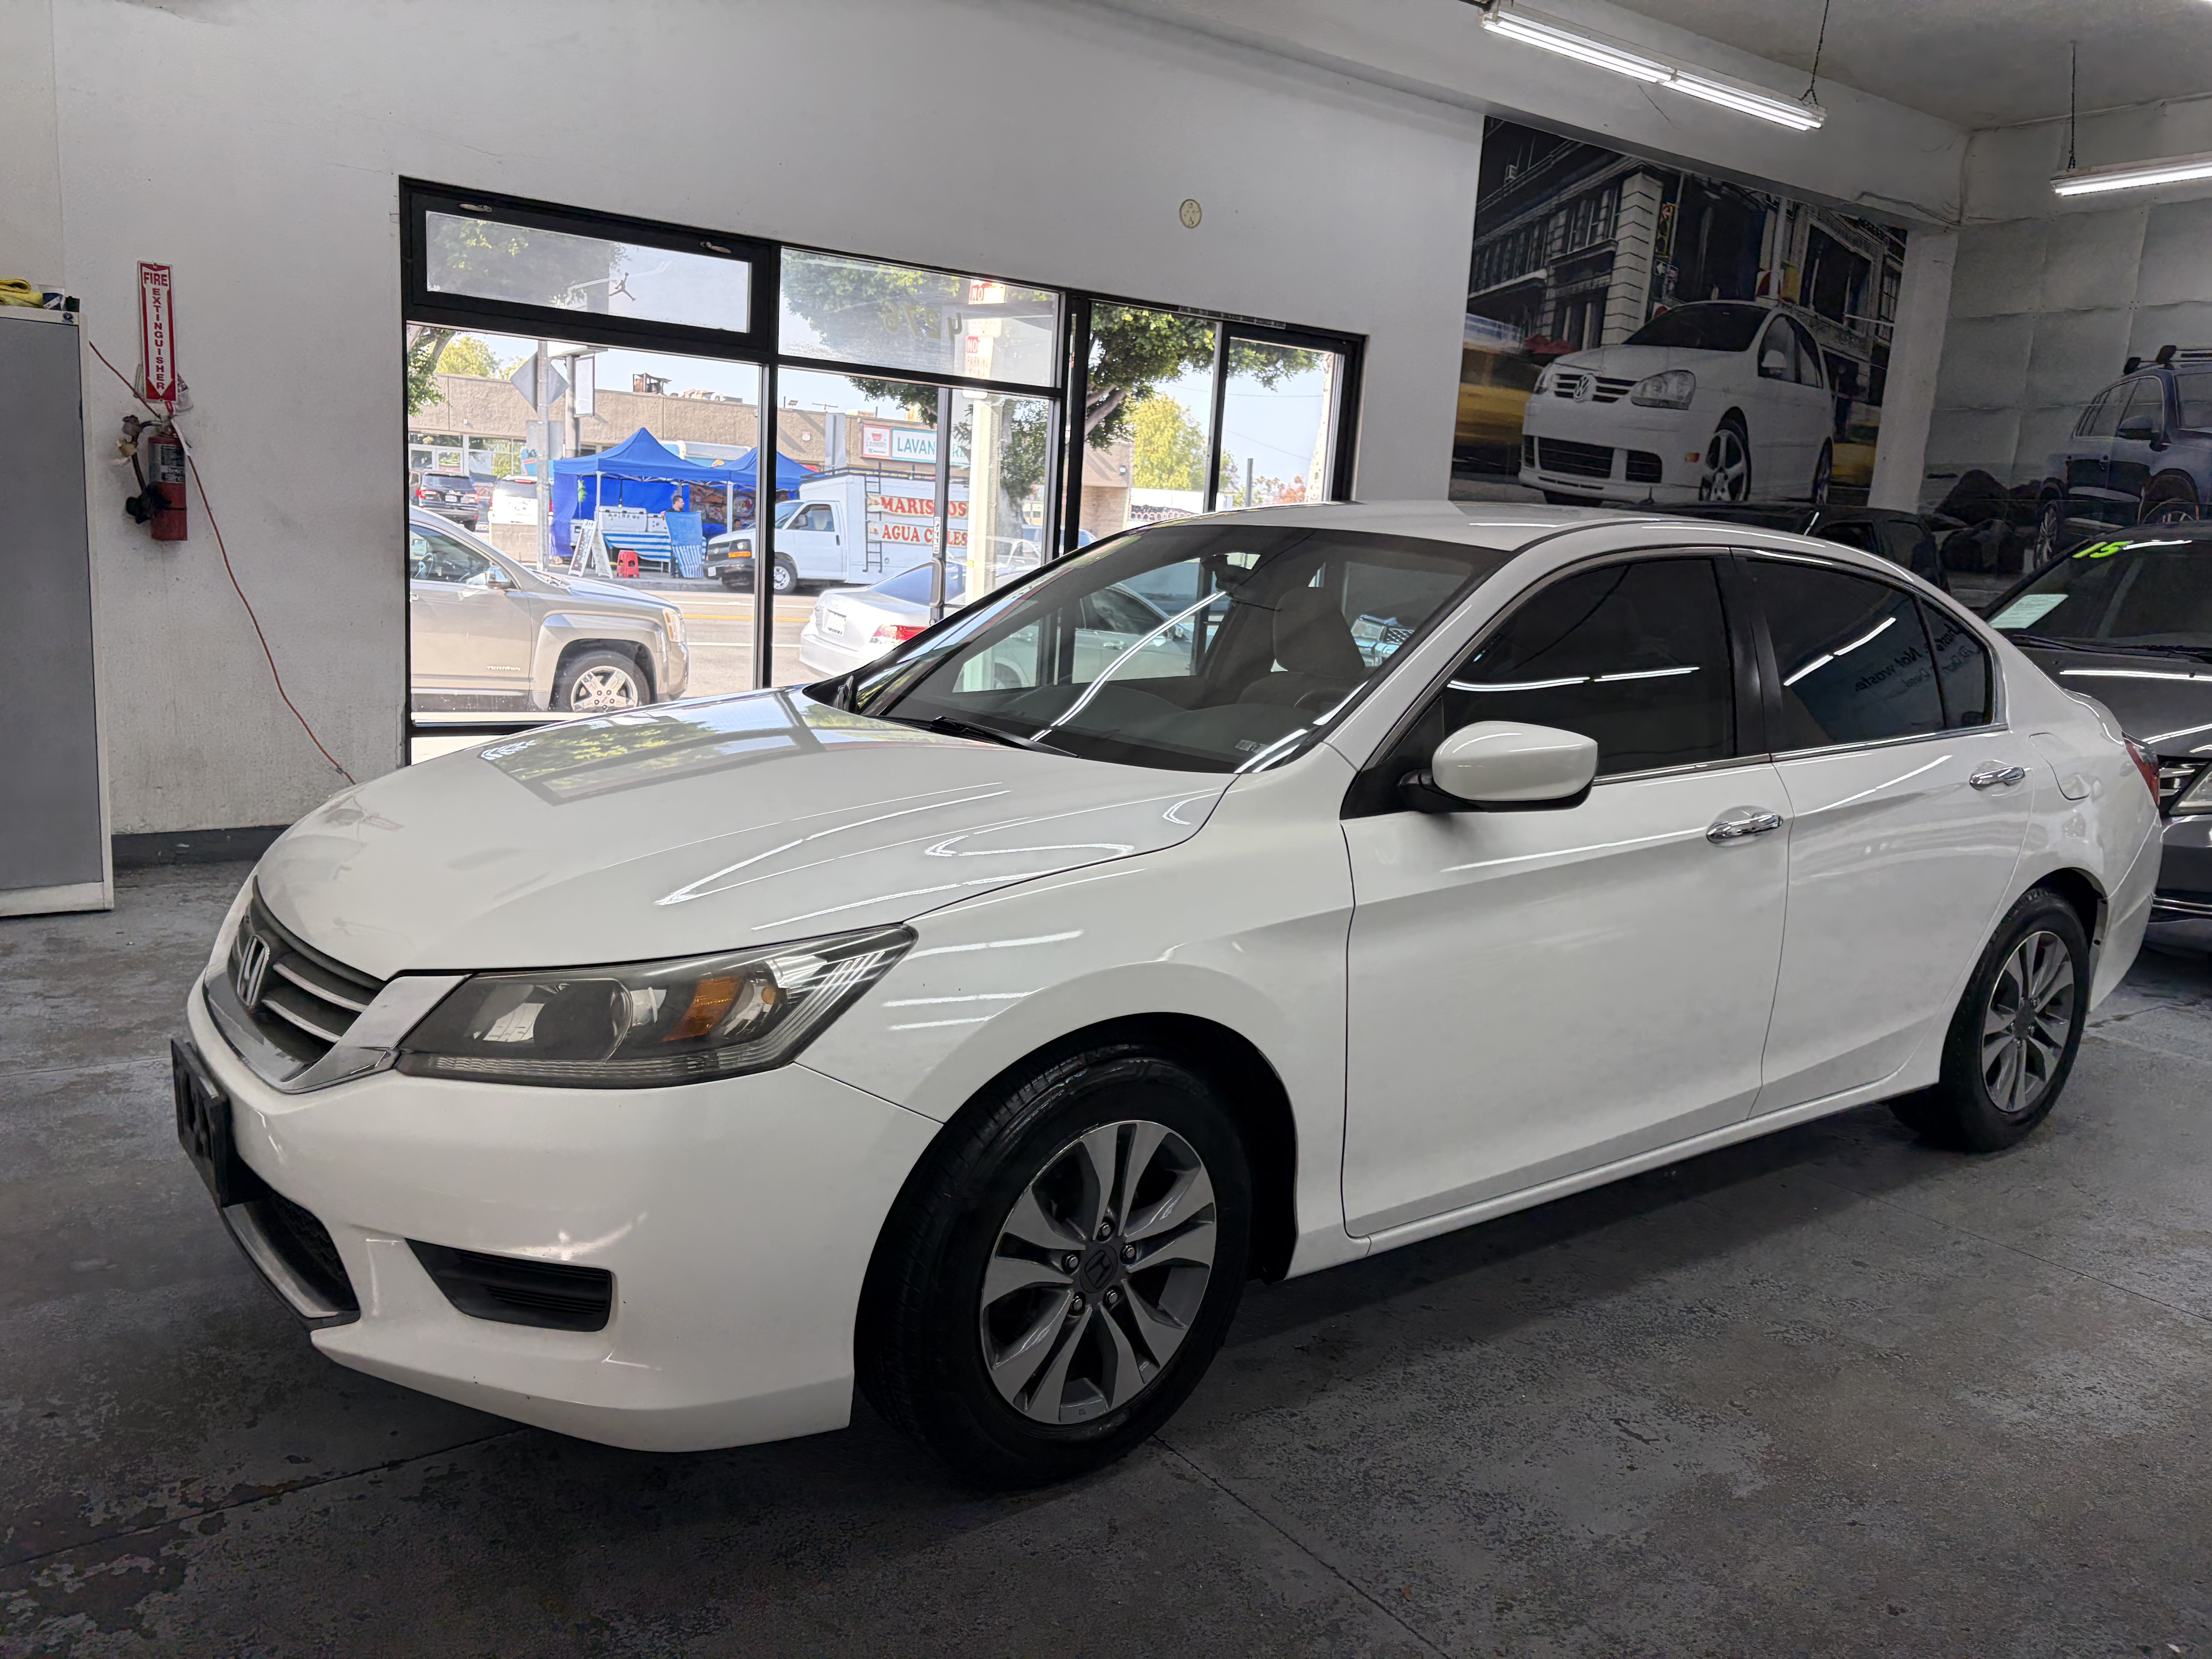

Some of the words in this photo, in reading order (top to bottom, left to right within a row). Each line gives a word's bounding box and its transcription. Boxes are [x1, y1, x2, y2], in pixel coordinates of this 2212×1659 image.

[143, 271, 168, 287] FIRE
[152, 288, 165, 390] EXTINGUISHER
[880, 496, 966, 517] MARISOS
[924, 528, 968, 546] CLES
